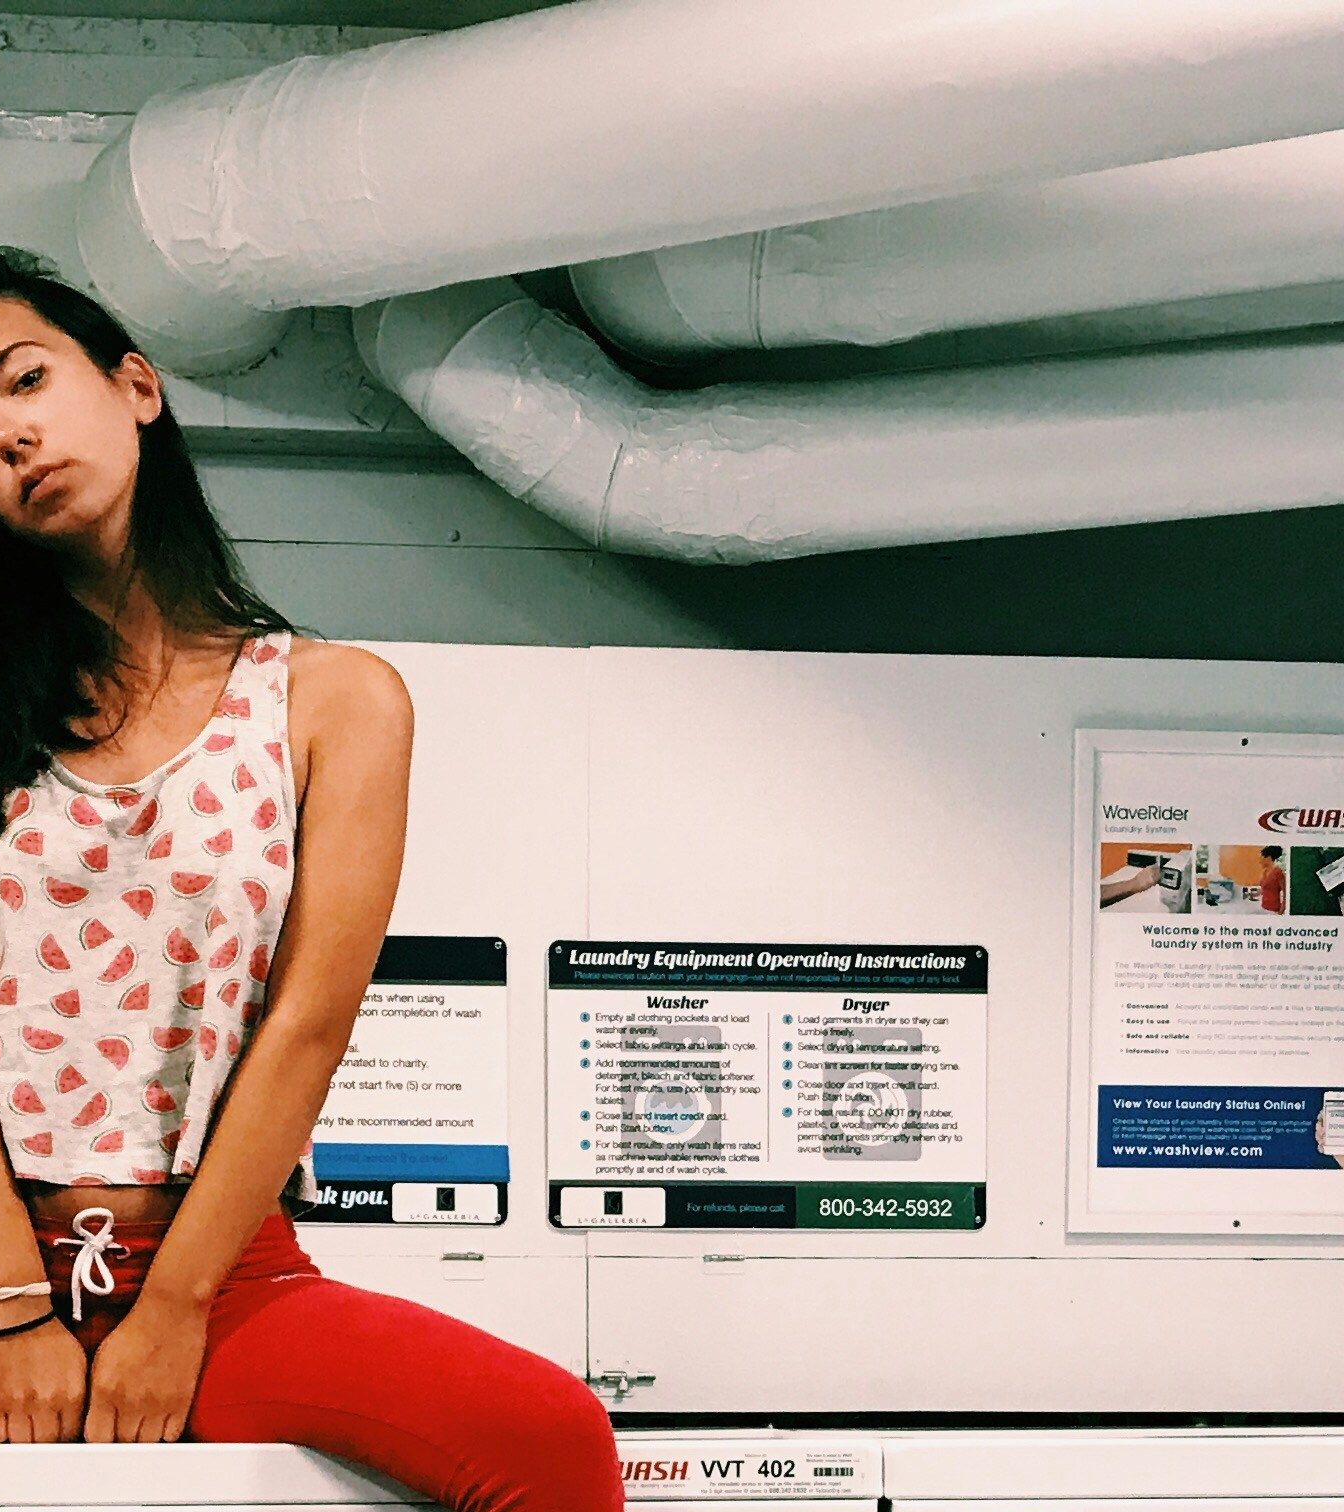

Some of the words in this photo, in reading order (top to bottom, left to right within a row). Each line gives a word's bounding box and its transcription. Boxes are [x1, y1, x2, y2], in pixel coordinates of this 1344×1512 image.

[1103, 805, 1188, 820] WaveRider
[1143, 926, 1199, 936] Welcome
[1204, 926, 1216, 935] to
[1220, 926, 1239, 936] the
[1243, 927, 1271, 937] most
[1276, 927, 1338, 937] advanced
[1151, 939, 1197, 950] laundry
[1202, 940, 1243, 950] system
[1248, 939, 1257, 949] in
[1262, 940, 1280, 949] the
[1285, 940, 1332, 952] industry
[569, 950, 650, 970] Laundry
[654, 951, 754, 970] Equipment
[757, 951, 851, 971] Operating
[855, 953, 966, 970] Instructions
[386, 994, 413, 1003] when
[417, 994, 445, 1005] using
[647, 996, 708, 1009] Washer
[842, 999, 890, 1013] Dryer
[382, 1008, 438, 1019] completion
[442, 1009, 452, 1017] of
[455, 1009, 481, 1018] wash
[595, 1013, 624, 1023] Empty
[626, 1014, 635, 1022] all
[638, 1014, 672, 1024] clothing
[675, 1014, 709, 1023] pockets
[712, 1014, 728, 1022] and
[798, 1016, 820, 1024] Load
[823, 1017, 863, 1025] garments
[865, 1016, 872, 1024] in
[875, 1016, 896, 1025] dryer
[912, 1017, 930, 1026] they
[340, 1058, 375, 1068] onated
[379, 1059, 389, 1067] to
[393, 1059, 429, 1070] charity.
[339, 1081, 356, 1090] not
[359, 1081, 382, 1090] start
[386, 1080, 403, 1090] five
[406, 1080, 419, 1091] (5)
[422, 1082, 432, 1091] or
[436, 1082, 462, 1091] more
[1114, 1099, 1141, 1109] View
[1146, 1100, 1172, 1109] Your
[1176, 1100, 1221, 1111] Laundry
[1226, 1100, 1260, 1109] Status
[1264, 1100, 1305, 1110] Online!
[338, 1117, 354, 1126] the
[357, 1117, 432, 1127] recommended
[436, 1118, 474, 1127] amount
[595, 1112, 621, 1120] Close
[635, 1112, 652, 1120] and
[680, 1112, 704, 1120] credit
[707, 1113, 727, 1121] card.
[1113, 1144, 1262, 1157] www.washview.com
[595, 1166, 634, 1175] promptly
[637, 1166, 645, 1174] at
[647, 1166, 663, 1174] end
[666, 1166, 675, 1174] of
[677, 1166, 700, 1174] wash
[703, 1167, 727, 1175] cycle.
[341, 1187, 388, 1208] you.
[819, 1199, 952, 1217] 800-342-5932
[701, 1460, 745, 1477] VVT
[757, 1460, 796, 1478] 402
